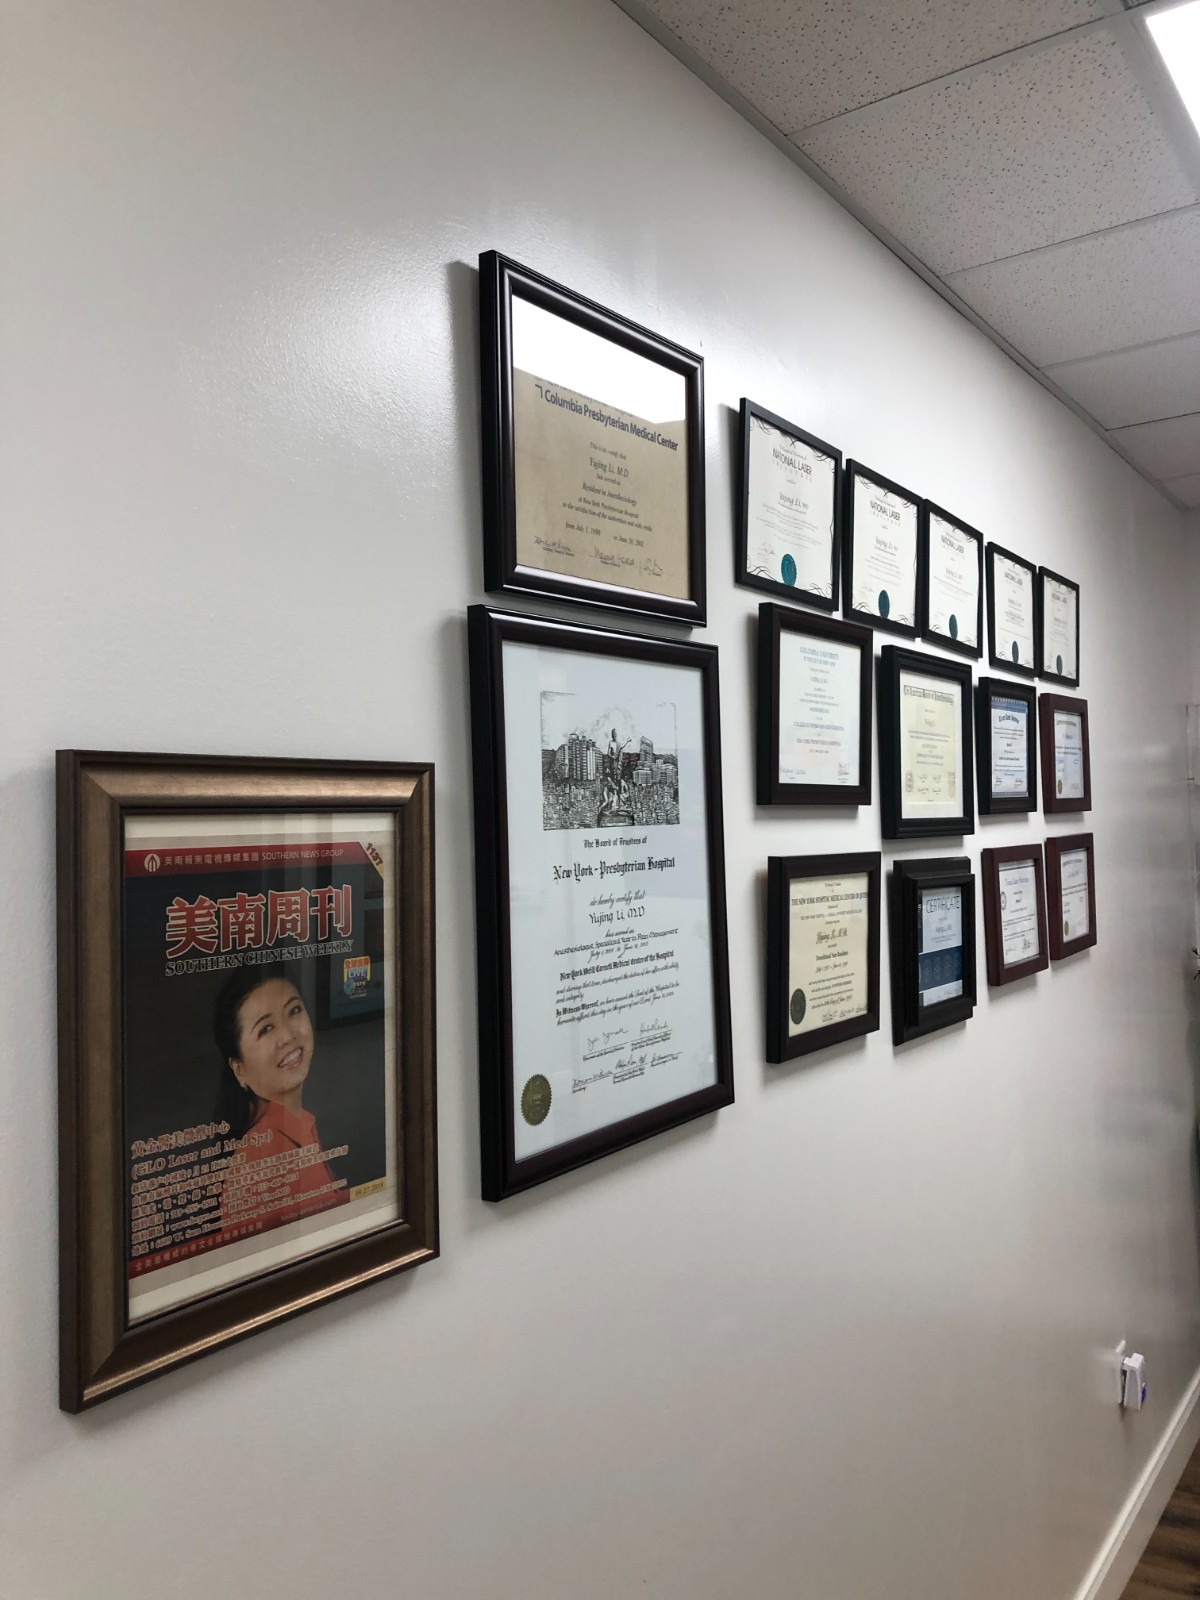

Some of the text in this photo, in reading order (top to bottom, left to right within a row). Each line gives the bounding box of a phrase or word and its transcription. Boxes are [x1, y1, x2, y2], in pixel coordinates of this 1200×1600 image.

[545, 390, 582, 415] Columbia
[584, 404, 630, 433] Presbyterian
[630, 423, 656, 443] Medical
[657, 434, 678, 451] Center
[772, 448, 796, 469] NATIONAL
[798, 460, 812, 476] LASER
[870, 500, 889, 518] NATIONAL
[584, 836, 648, 848] The Board of Trustees of
[262, 848, 344, 860] SOUTHERN NEWS GROUP
[553, 856, 675, 883] New York Presbyterian Hospital
[633, 890, 646, 900] that
[926, 895, 960, 913] CERTIFICATE
[165, 884, 352, 959] 美南周刊
[589, 910, 614, 927] Yujing
[165, 939, 354, 976] SOUTHERN CHINESE WEEKLY
[560, 972, 571, 981] New
[571, 970, 583, 980] York
[583, 966, 595, 975] Weill
[596, 964, 612, 973] Cornell
[613, 960, 630, 970] Medical
[631, 956, 645, 966] Center
[656, 950, 674, 960] Hospital
[348, 968, 367, 978] LIVE
[562, 1004, 581, 1015] Witness
[168, 1150, 198, 1168] Laser
[201, 1142, 221, 1158] and
[224, 1136, 248, 1152] Med
[250, 1129, 272, 1147] Spa)
